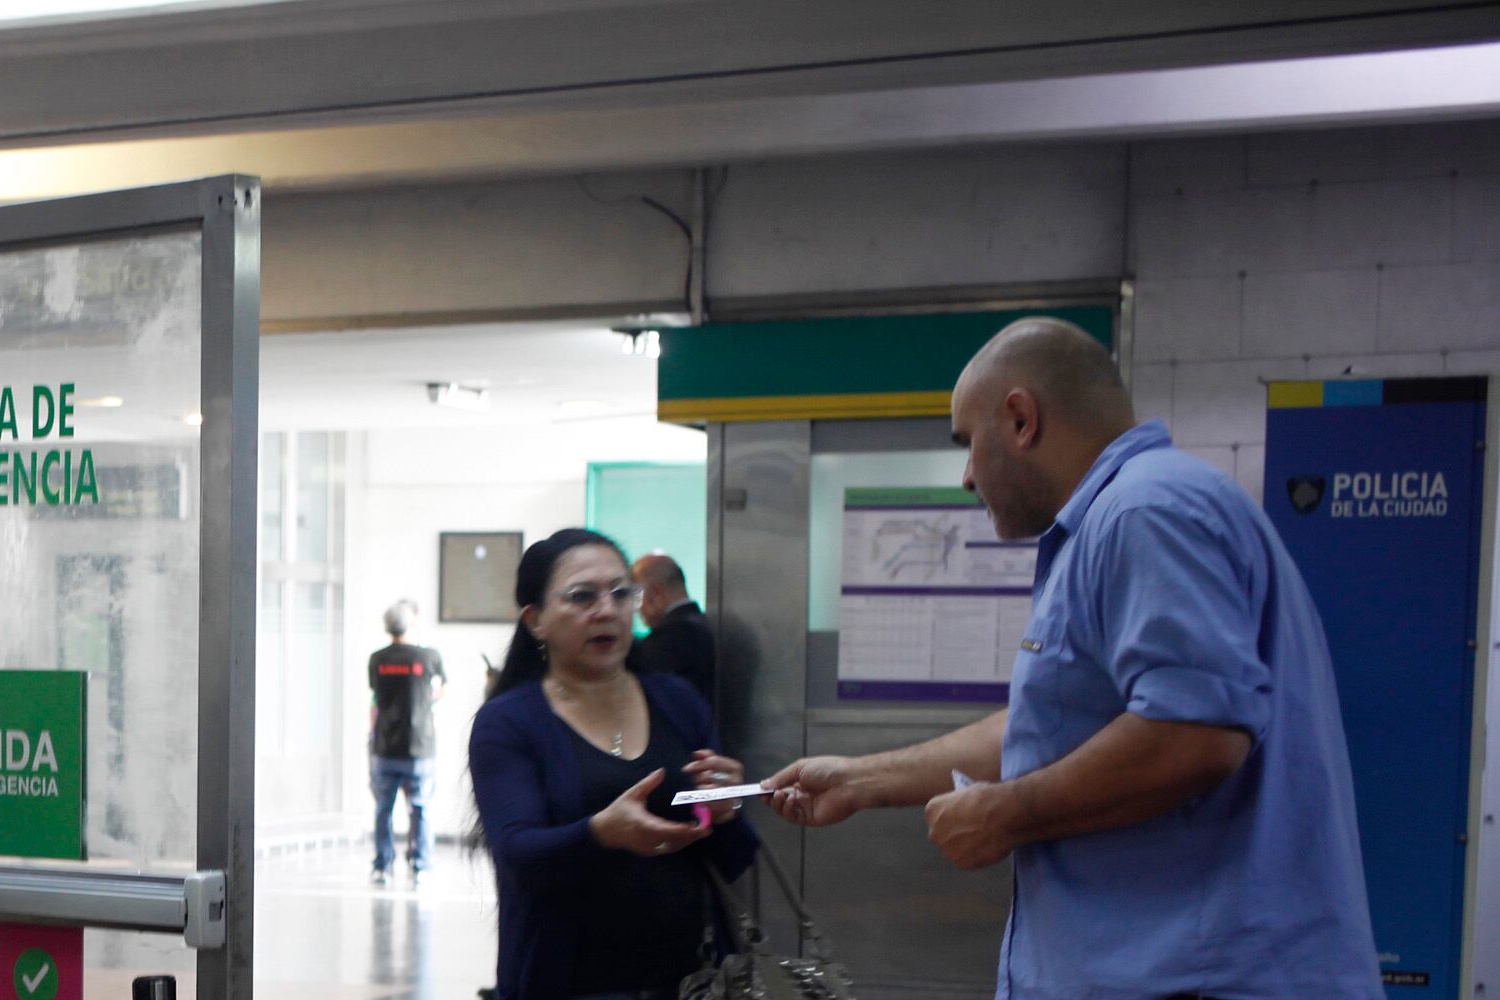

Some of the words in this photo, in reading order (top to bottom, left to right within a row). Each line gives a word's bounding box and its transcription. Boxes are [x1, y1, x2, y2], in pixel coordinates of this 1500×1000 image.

[33, 382, 75, 438] DE
[1333, 472, 1448, 499] POLICIA
[1331, 500, 1353, 517] DE
[1358, 500, 1379, 517] LA
[1383, 499, 1448, 517] CIUDAD
